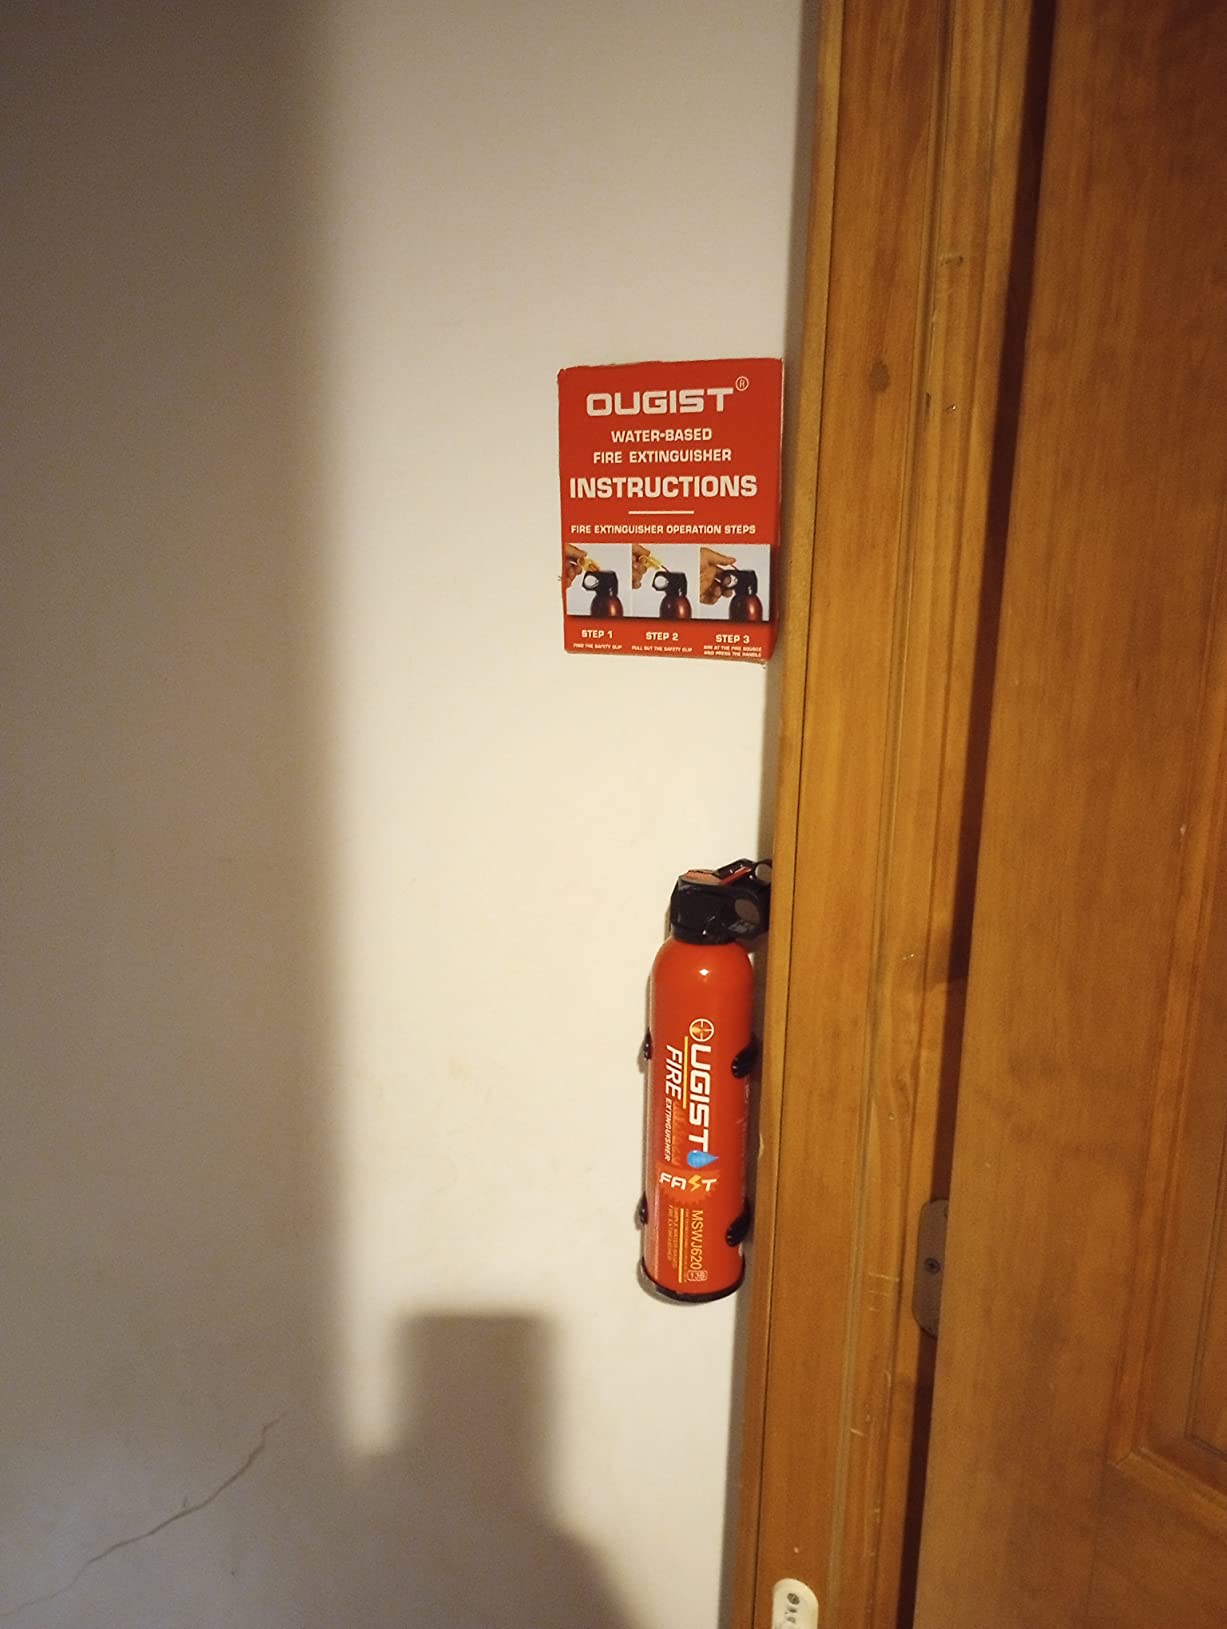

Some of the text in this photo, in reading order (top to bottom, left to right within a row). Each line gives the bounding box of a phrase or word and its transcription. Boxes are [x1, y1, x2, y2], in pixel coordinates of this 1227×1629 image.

[586, 387, 734, 417] OUGIST
[611, 428, 713, 443] WATER-BASED
[593, 448, 732, 464] FIRE EXTINGUISHER
[569, 474, 758, 499] INSTRUCTIONS
[571, 525, 756, 534] FIRE EXTINGUISHER OPERATION STEPS
[581, 629, 613, 639] STEP 1
[645, 631, 679, 641] STEP 2
[715, 634, 750, 644] STEP 3
[663, 1044, 683, 1162] FIRE EXTINGUISHER
[690, 1210, 704, 1270] MSWJ620
